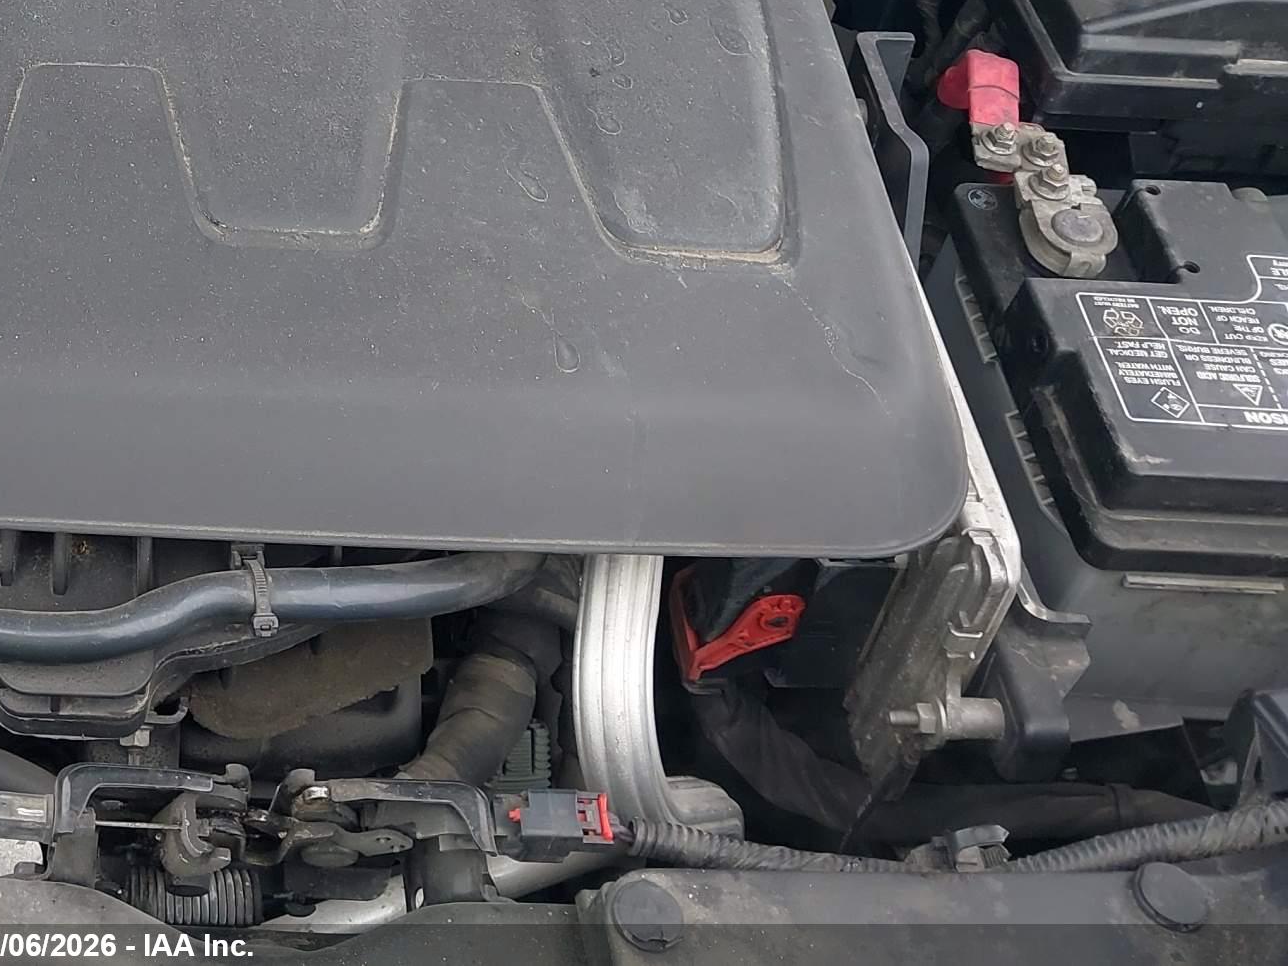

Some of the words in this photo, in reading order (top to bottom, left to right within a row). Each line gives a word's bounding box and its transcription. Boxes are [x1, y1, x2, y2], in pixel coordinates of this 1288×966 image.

[1156, 305, 1199, 317] OPEN.
[1171, 316, 1199, 326] NOT
[1229, 315, 1261, 325] REACH
[1178, 327, 1201, 335] DO
[1232, 324, 1251, 333] THE
[1251, 326, 1265, 334] OF
[1245, 334, 1269, 342] KEEP
[1141, 342, 1166, 350] HELP
[1105, 348, 1149, 357] MEDICAL
[1150, 350, 1168, 359] GET
[1211, 347, 1248, 356] SEVERE
[1184, 353, 1200, 361] OR
[1199, 354, 1252, 364] BLINDNESS
[1149, 363, 1175, 371] WITH
[1203, 363, 1235, 372] CAUSE
[1235, 365, 1256, 373] CAN
[1118, 369, 1179, 379] IMMEDIATELY
[1123, 376, 1150, 385] EYES
[1150, 378, 1182, 387] FLUSH
[1243, 411, 1288, 425] ISON
